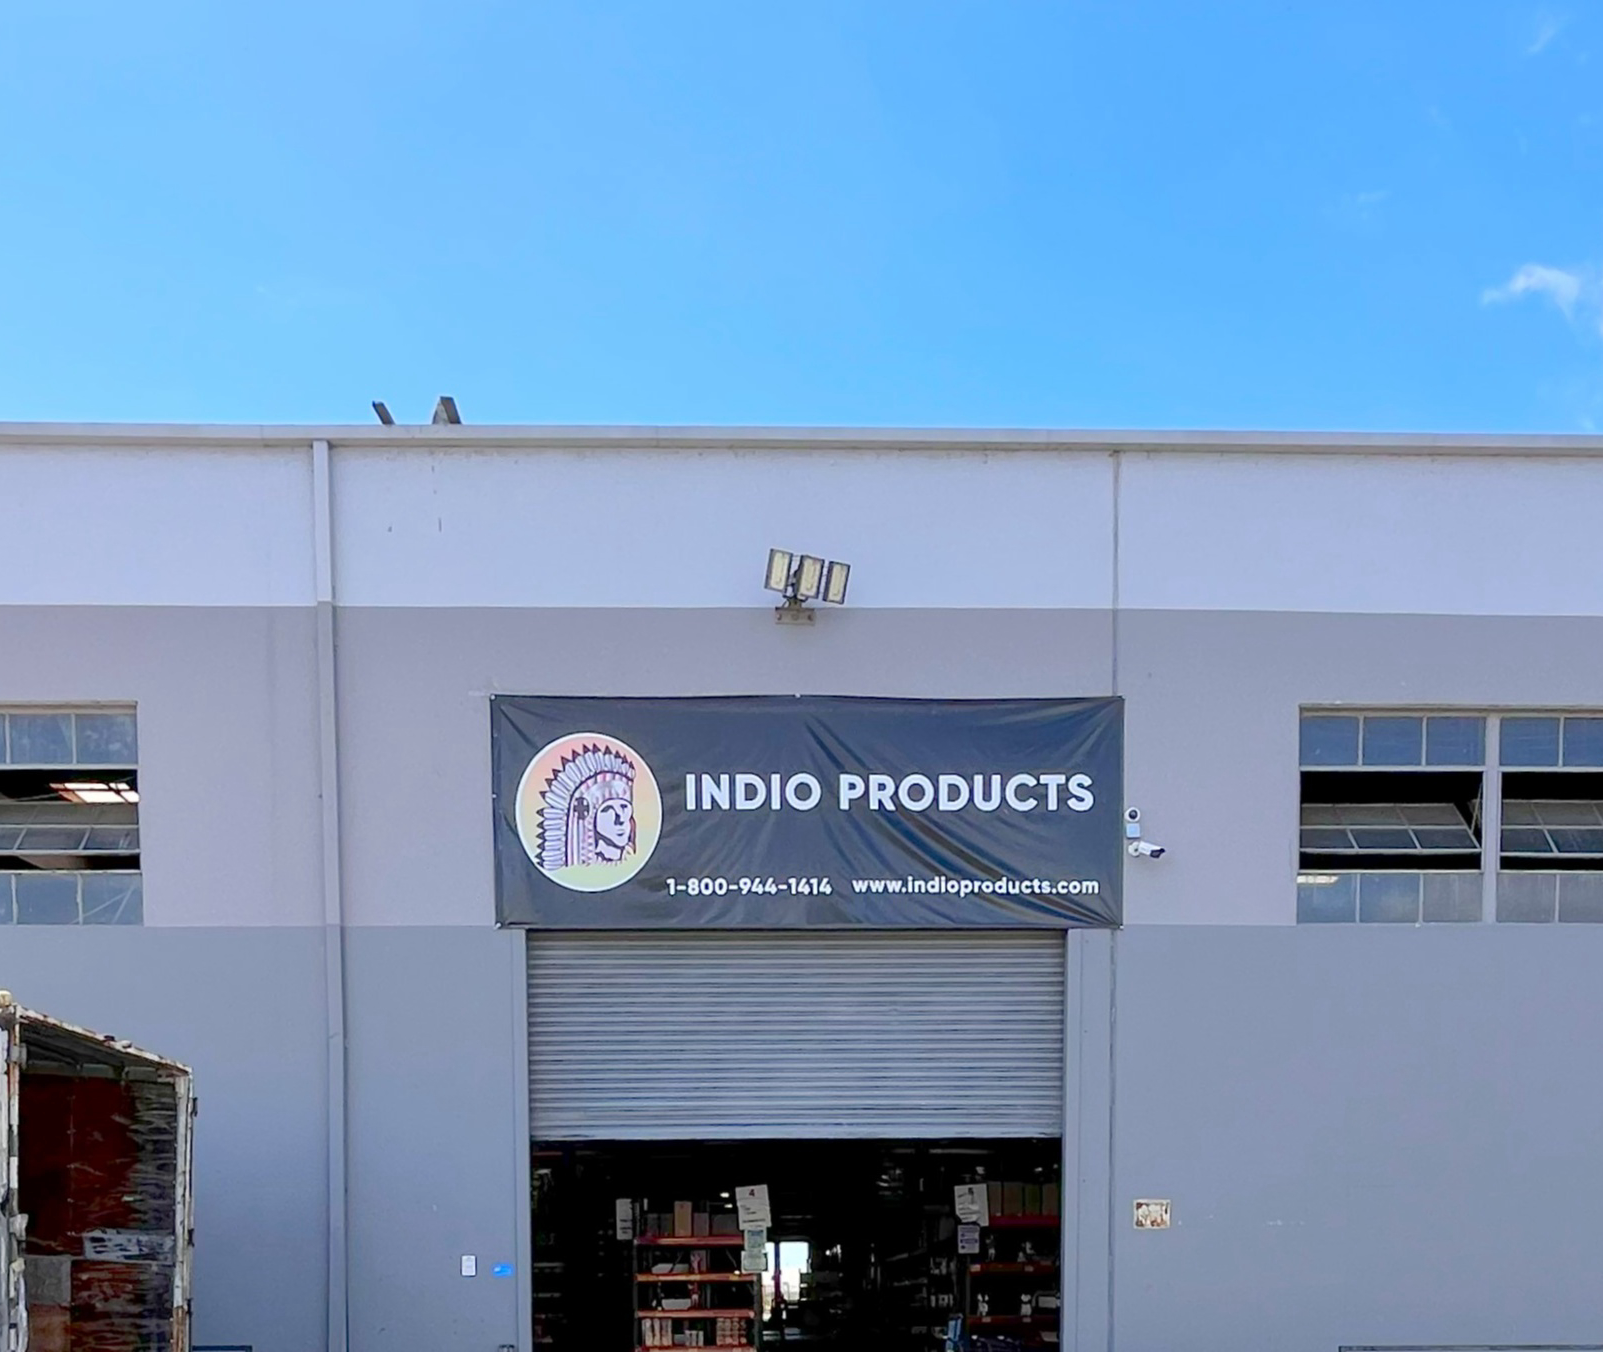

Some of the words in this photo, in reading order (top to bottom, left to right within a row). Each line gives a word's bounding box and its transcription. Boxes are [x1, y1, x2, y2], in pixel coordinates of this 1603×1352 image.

[685, 773, 822, 811] INDIO
[839, 773, 1094, 812] PRODUCTS
[666, 876, 833, 896] 1-800-944-1414
[851, 875, 1099, 898] www.indioproducts.com
